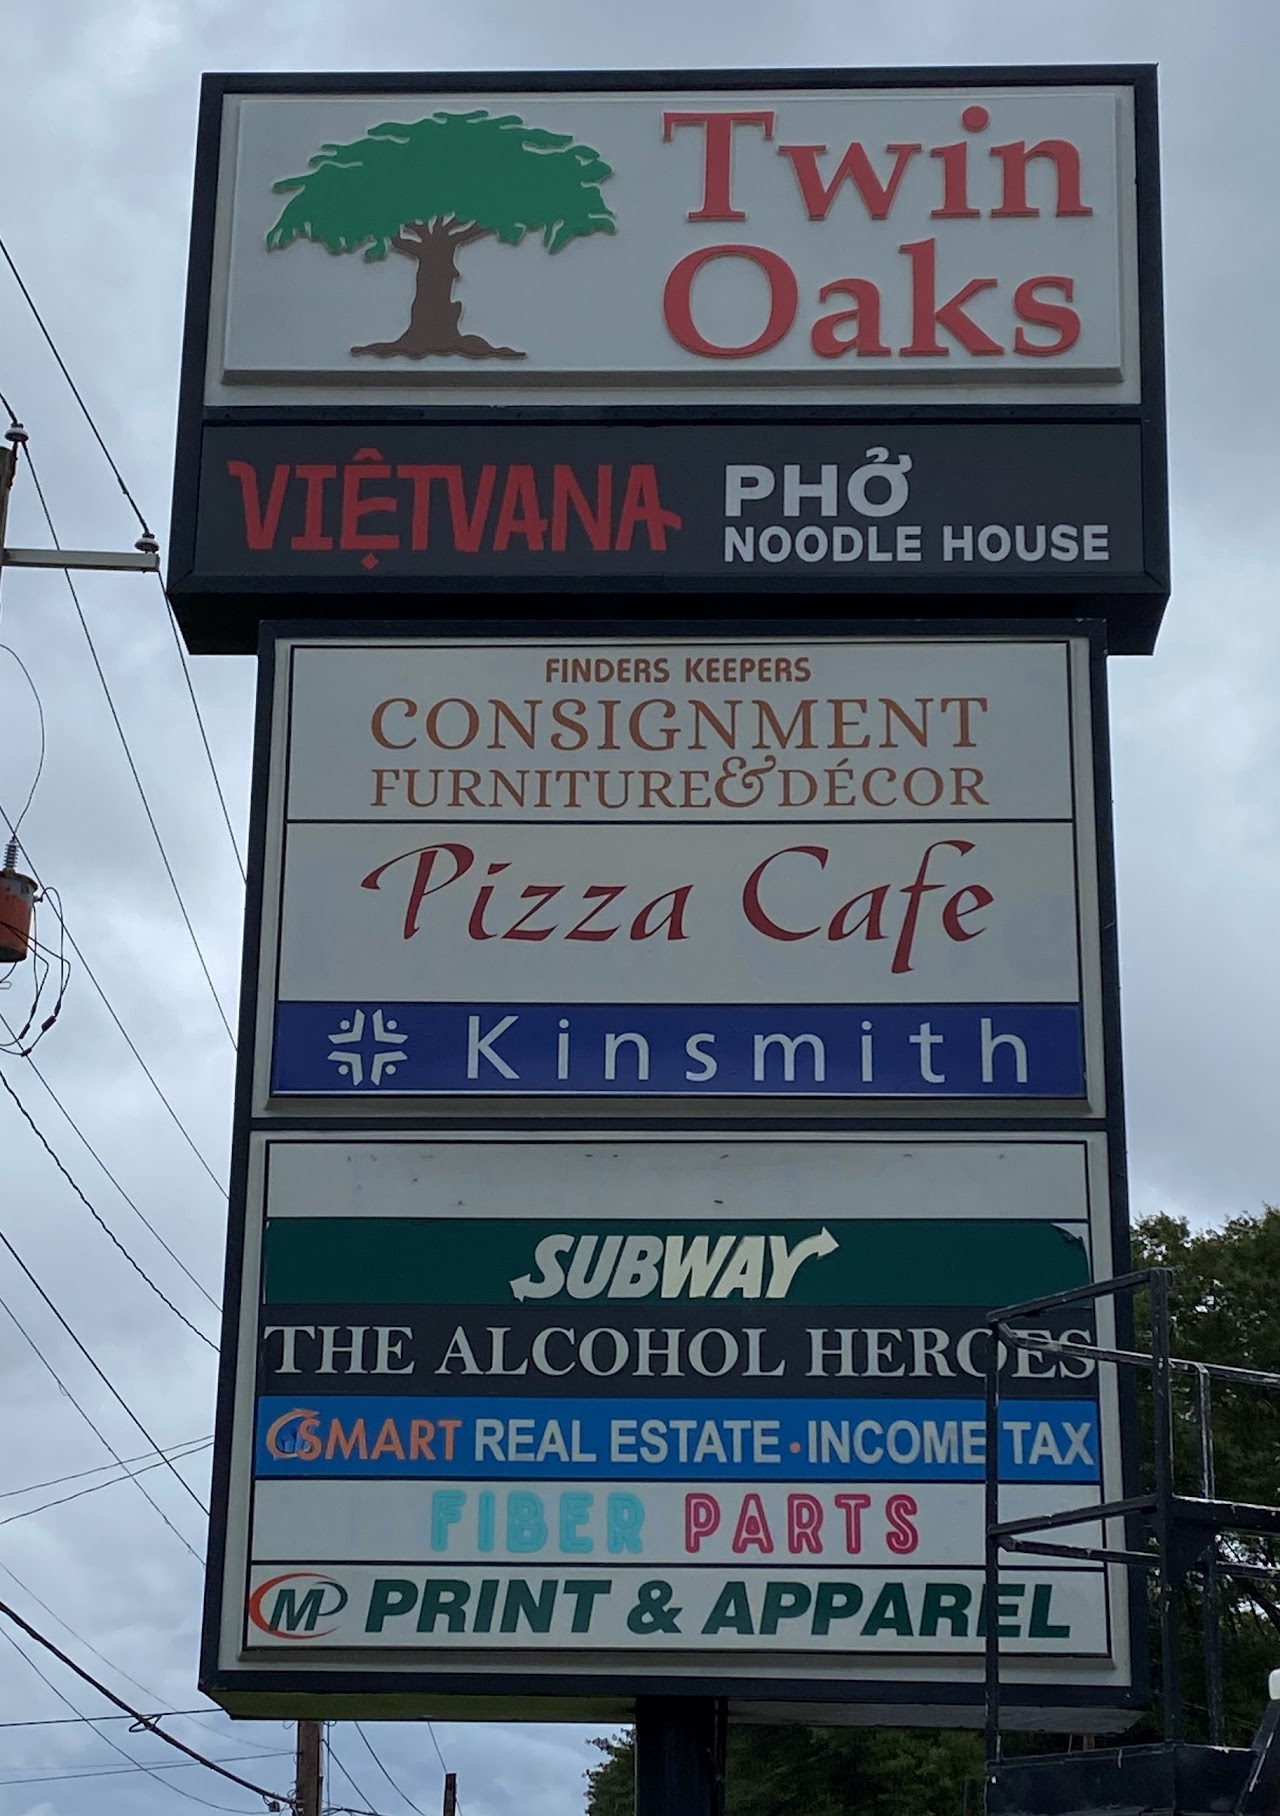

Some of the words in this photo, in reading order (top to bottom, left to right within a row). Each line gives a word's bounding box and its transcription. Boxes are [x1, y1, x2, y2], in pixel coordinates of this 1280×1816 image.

[662, 106, 1094, 223] Twin
[662, 236, 1083, 360] Oaks
[724, 446, 913, 518] PHỞ
[723, 525, 923, 564] NOODLE
[942, 524, 1110, 564] HOUSE
[546, 658, 670, 683] FINDERS
[686, 658, 811, 683] KEEPERS
[370, 697, 988, 752] CONSIGNMENT
[360, 842, 694, 943] Pizza
[741, 839, 995, 975] Cafe
[466, 1015, 1030, 1084] Kinsmith
[510, 1226, 840, 1303] SUBWAY
[264, 1325, 416, 1378] THE
[434, 1327, 788, 1378] ALCOHOL
[805, 1328, 1096, 1381] HEROES
[297, 1419, 462, 1462] SMART
[474, 1418, 598, 1463] REAL
[609, 1418, 782, 1465] ESTATE
[807, 1420, 986, 1466] INCOME
[1002, 1420, 1095, 1467] TAX
[430, 1489, 646, 1553] FIBER
[684, 1493, 919, 1553] PARTS
[365, 1578, 612, 1634] PRINT
[700, 1581, 1071, 1639] APPAREL
